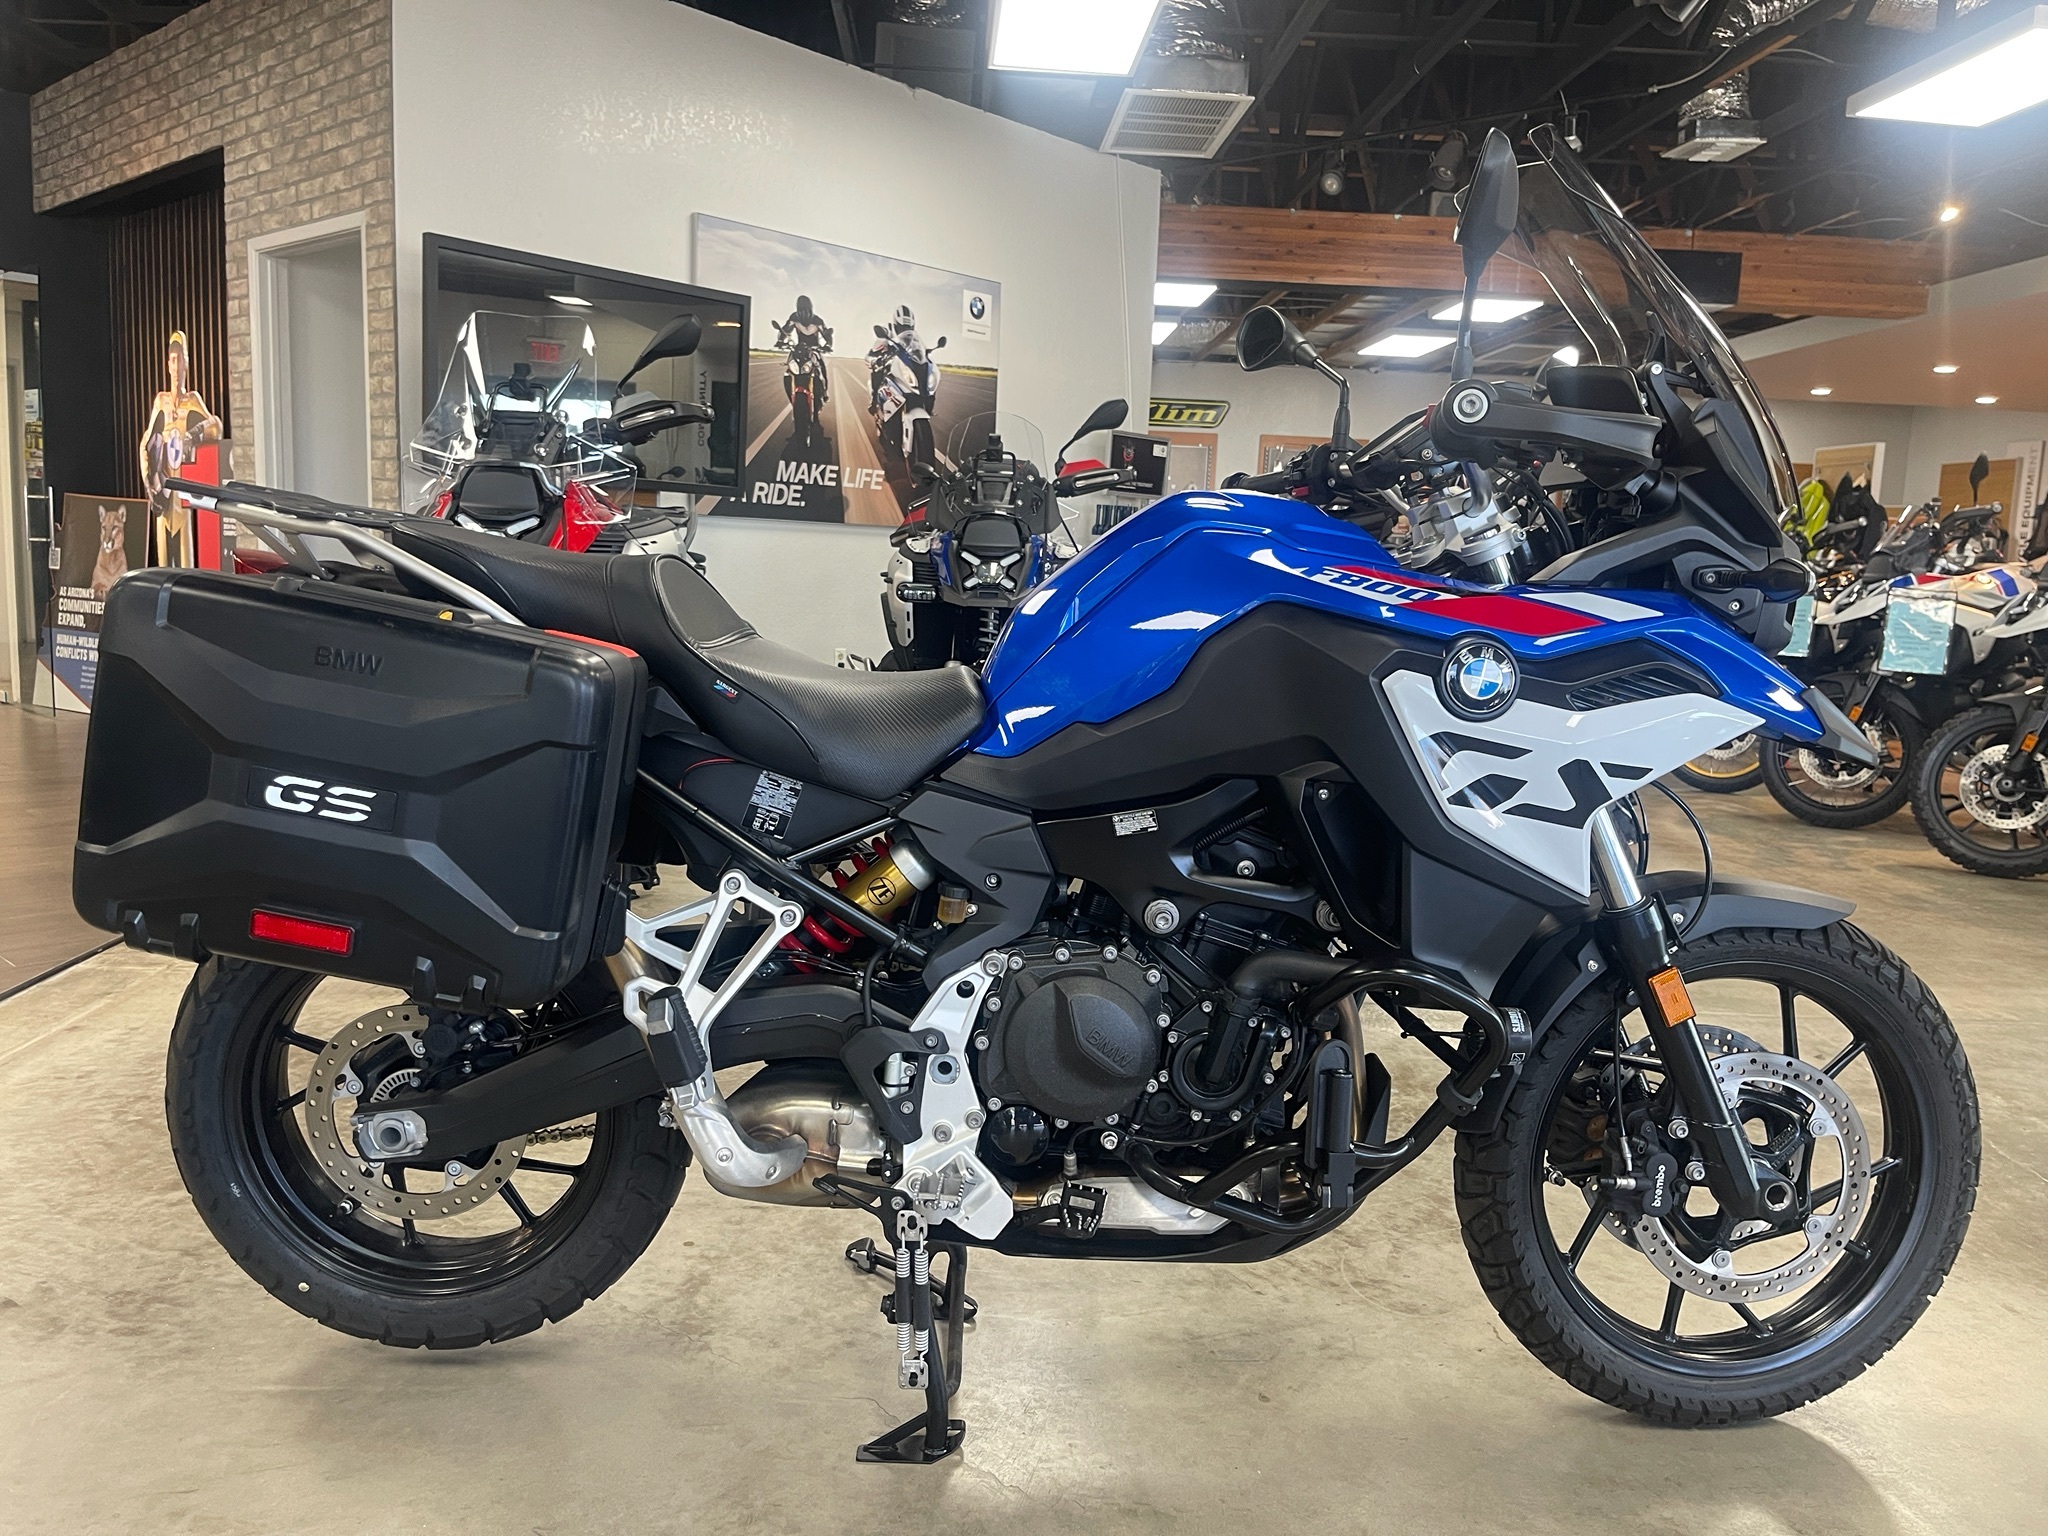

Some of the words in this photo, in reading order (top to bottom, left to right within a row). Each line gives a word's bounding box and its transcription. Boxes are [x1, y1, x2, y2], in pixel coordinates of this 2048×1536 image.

[776, 460, 839, 487] MAKE
[843, 467, 885, 490] LIFE
[2021, 448, 2039, 529] EQUIPMENT
[752, 481, 806, 507] RIDE.
[60, 586, 67, 596] AS
[67, 587, 95, 599] ARIZONA'S
[57, 612, 86, 628] EXPAND,
[55, 645, 88, 661] CONFLICTS
[315, 646, 384, 677] BMW
[1459, 646, 1512, 674] BMW
[265, 775, 377, 822] GS
[870, 878, 896, 905] ZF
[1086, 1027, 1135, 1067] BMW
[1651, 1164, 1666, 1207] brembo
